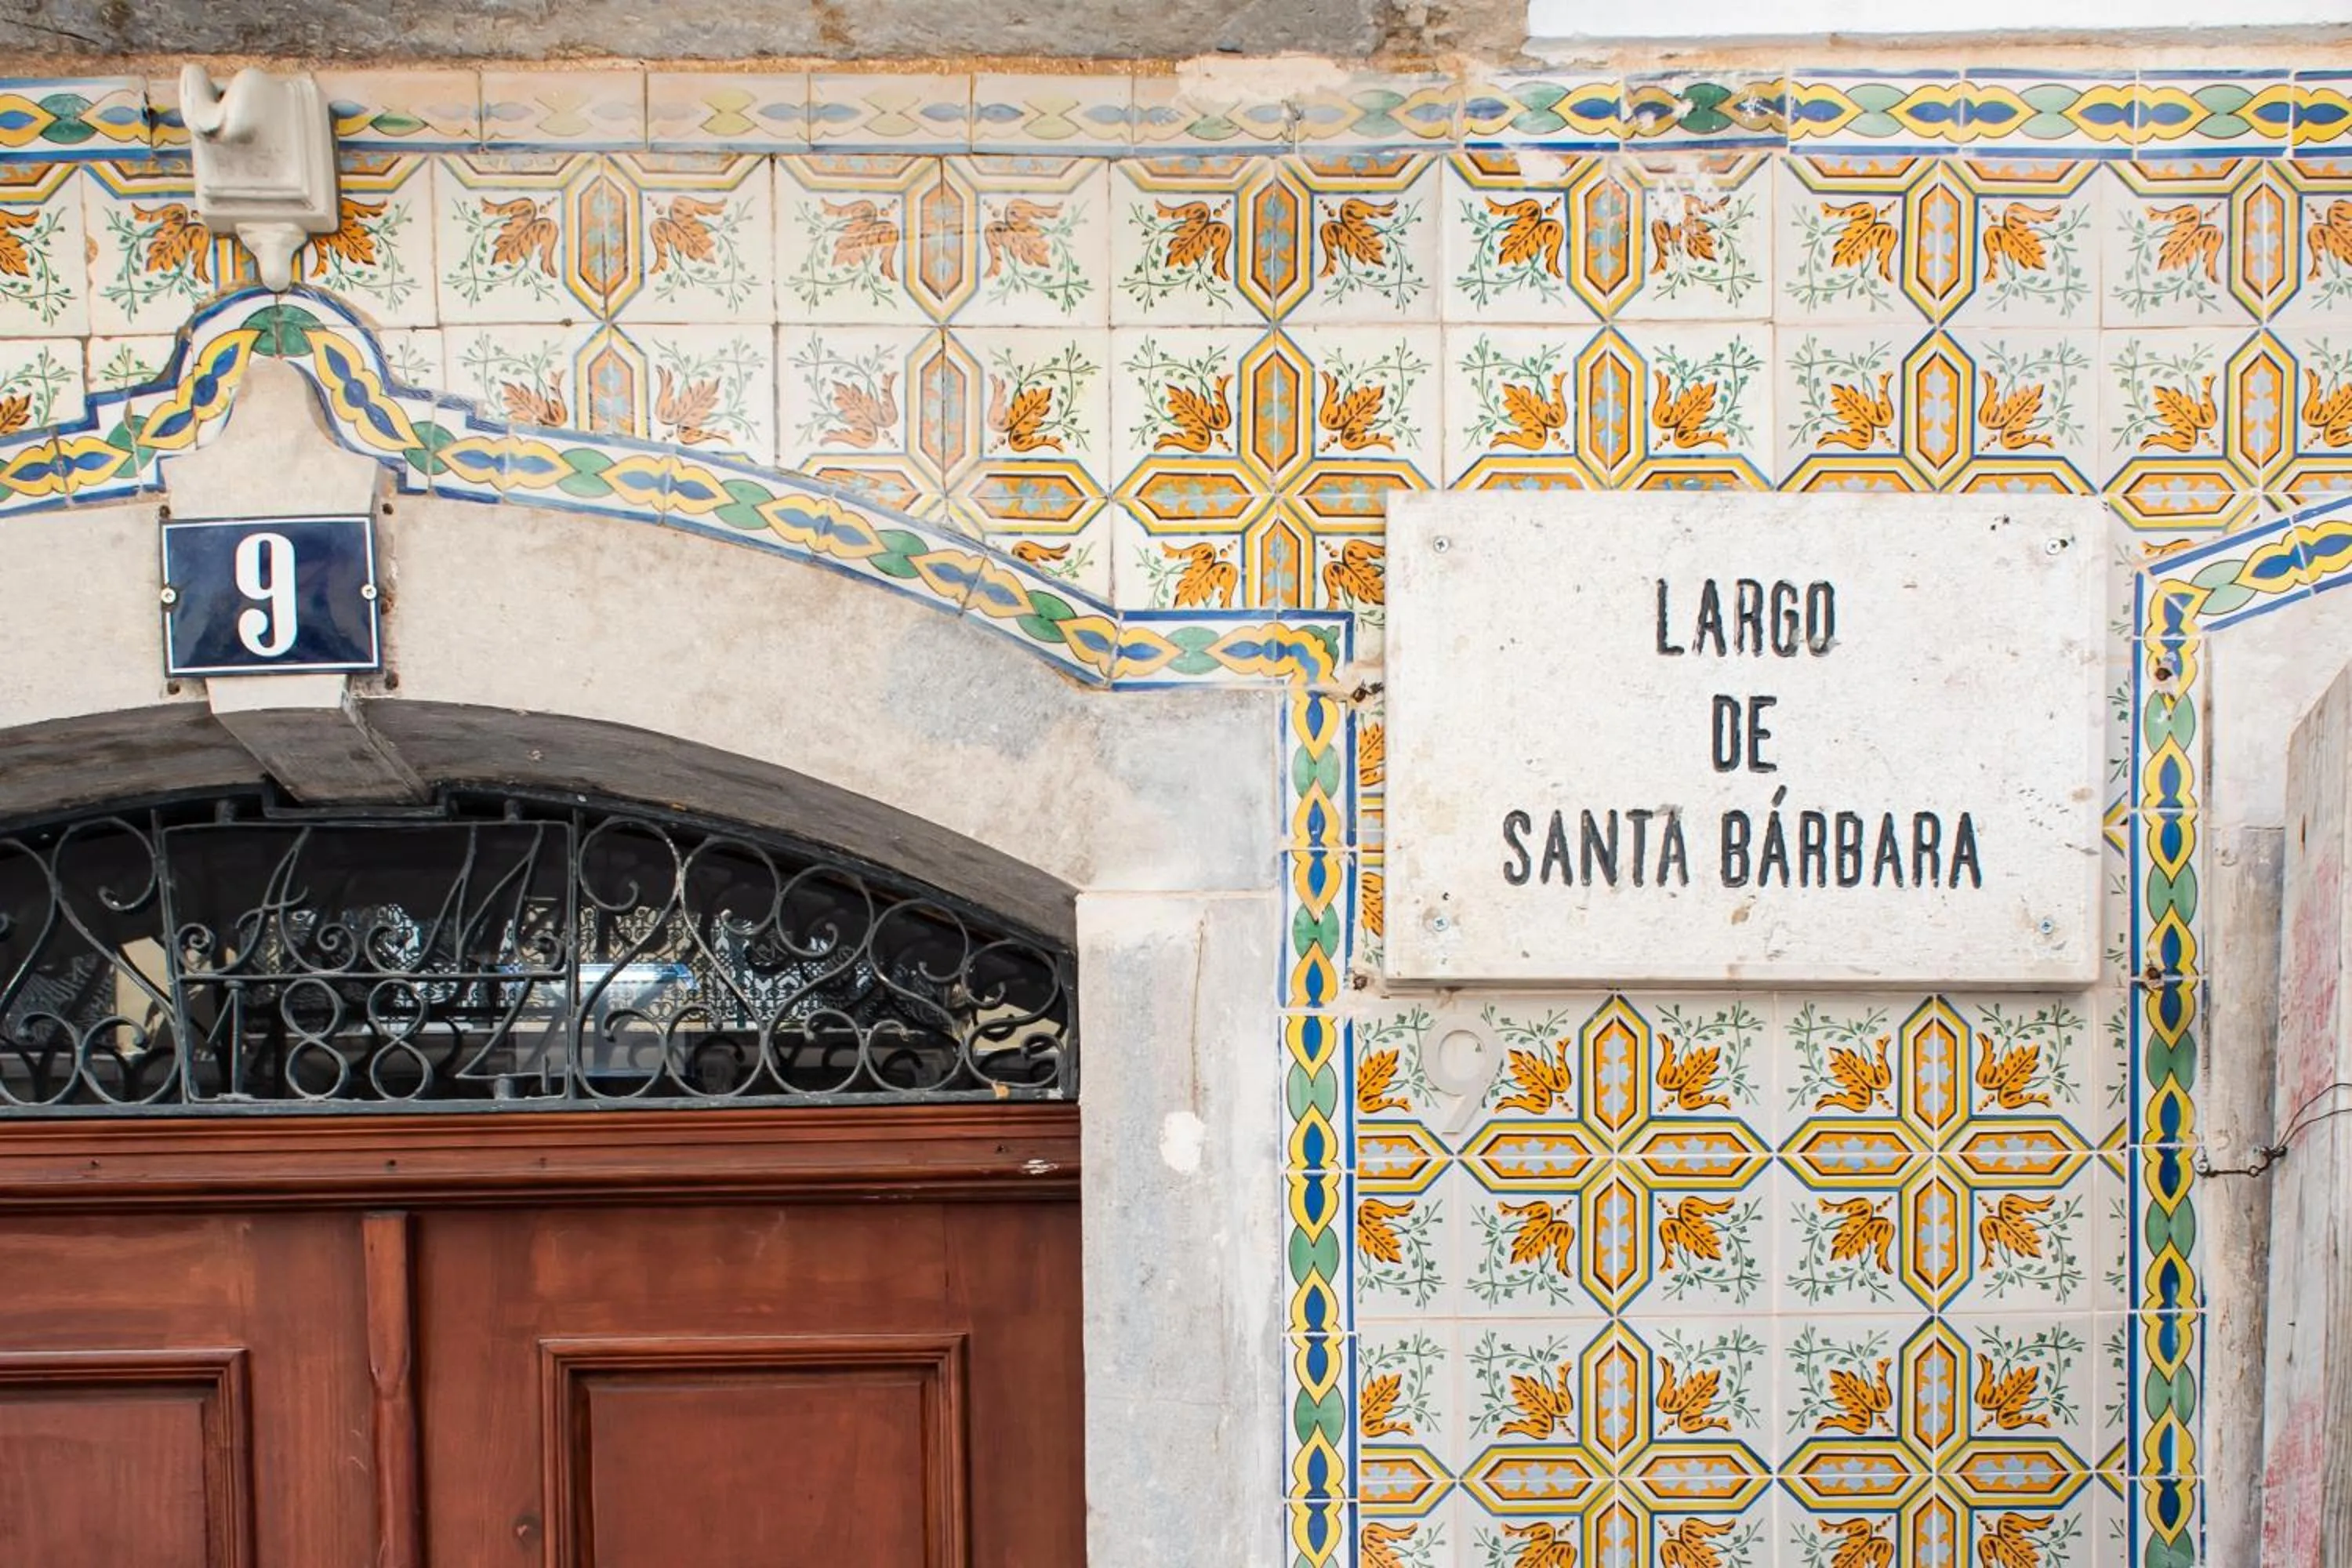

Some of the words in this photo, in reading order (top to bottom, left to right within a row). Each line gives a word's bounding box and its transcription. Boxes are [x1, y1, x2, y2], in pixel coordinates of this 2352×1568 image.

[235, 532, 298, 658] 9
[1656, 578, 1835, 657] LARGO
[1711, 694, 1778, 774] DE
[1502, 808, 1690, 887] SANTA
[1719, 785, 1983, 890] BÁRBARA
[207, 977, 551, 1101] 1884
[1420, 1012, 1504, 1134] 9
